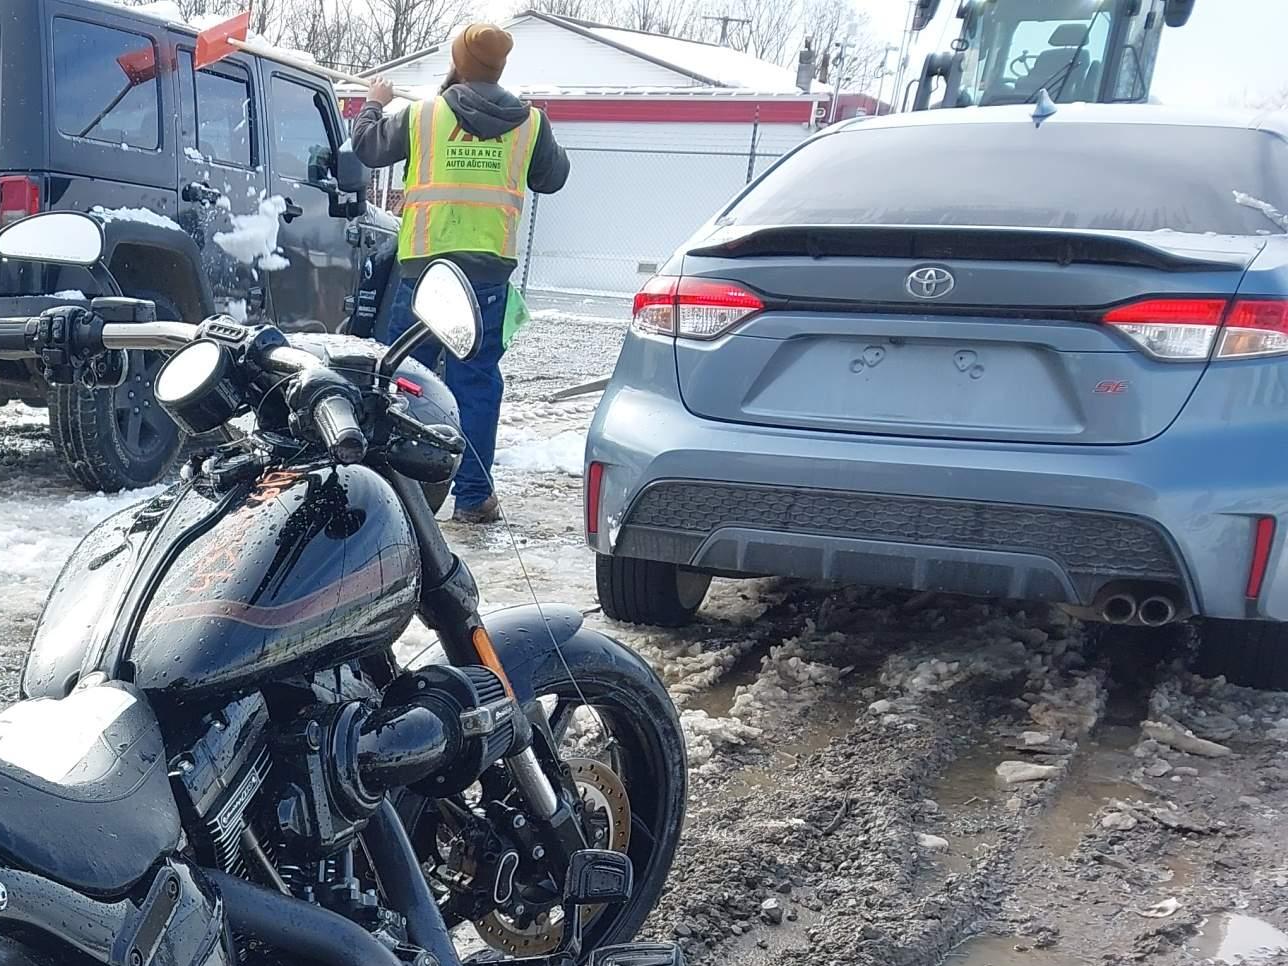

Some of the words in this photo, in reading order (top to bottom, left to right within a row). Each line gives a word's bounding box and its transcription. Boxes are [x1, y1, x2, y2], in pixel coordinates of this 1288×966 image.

[446, 148, 503, 158] INSURANCE
[445, 160, 465, 169] AUTO
[466, 160, 501, 169] AUCTIONS
